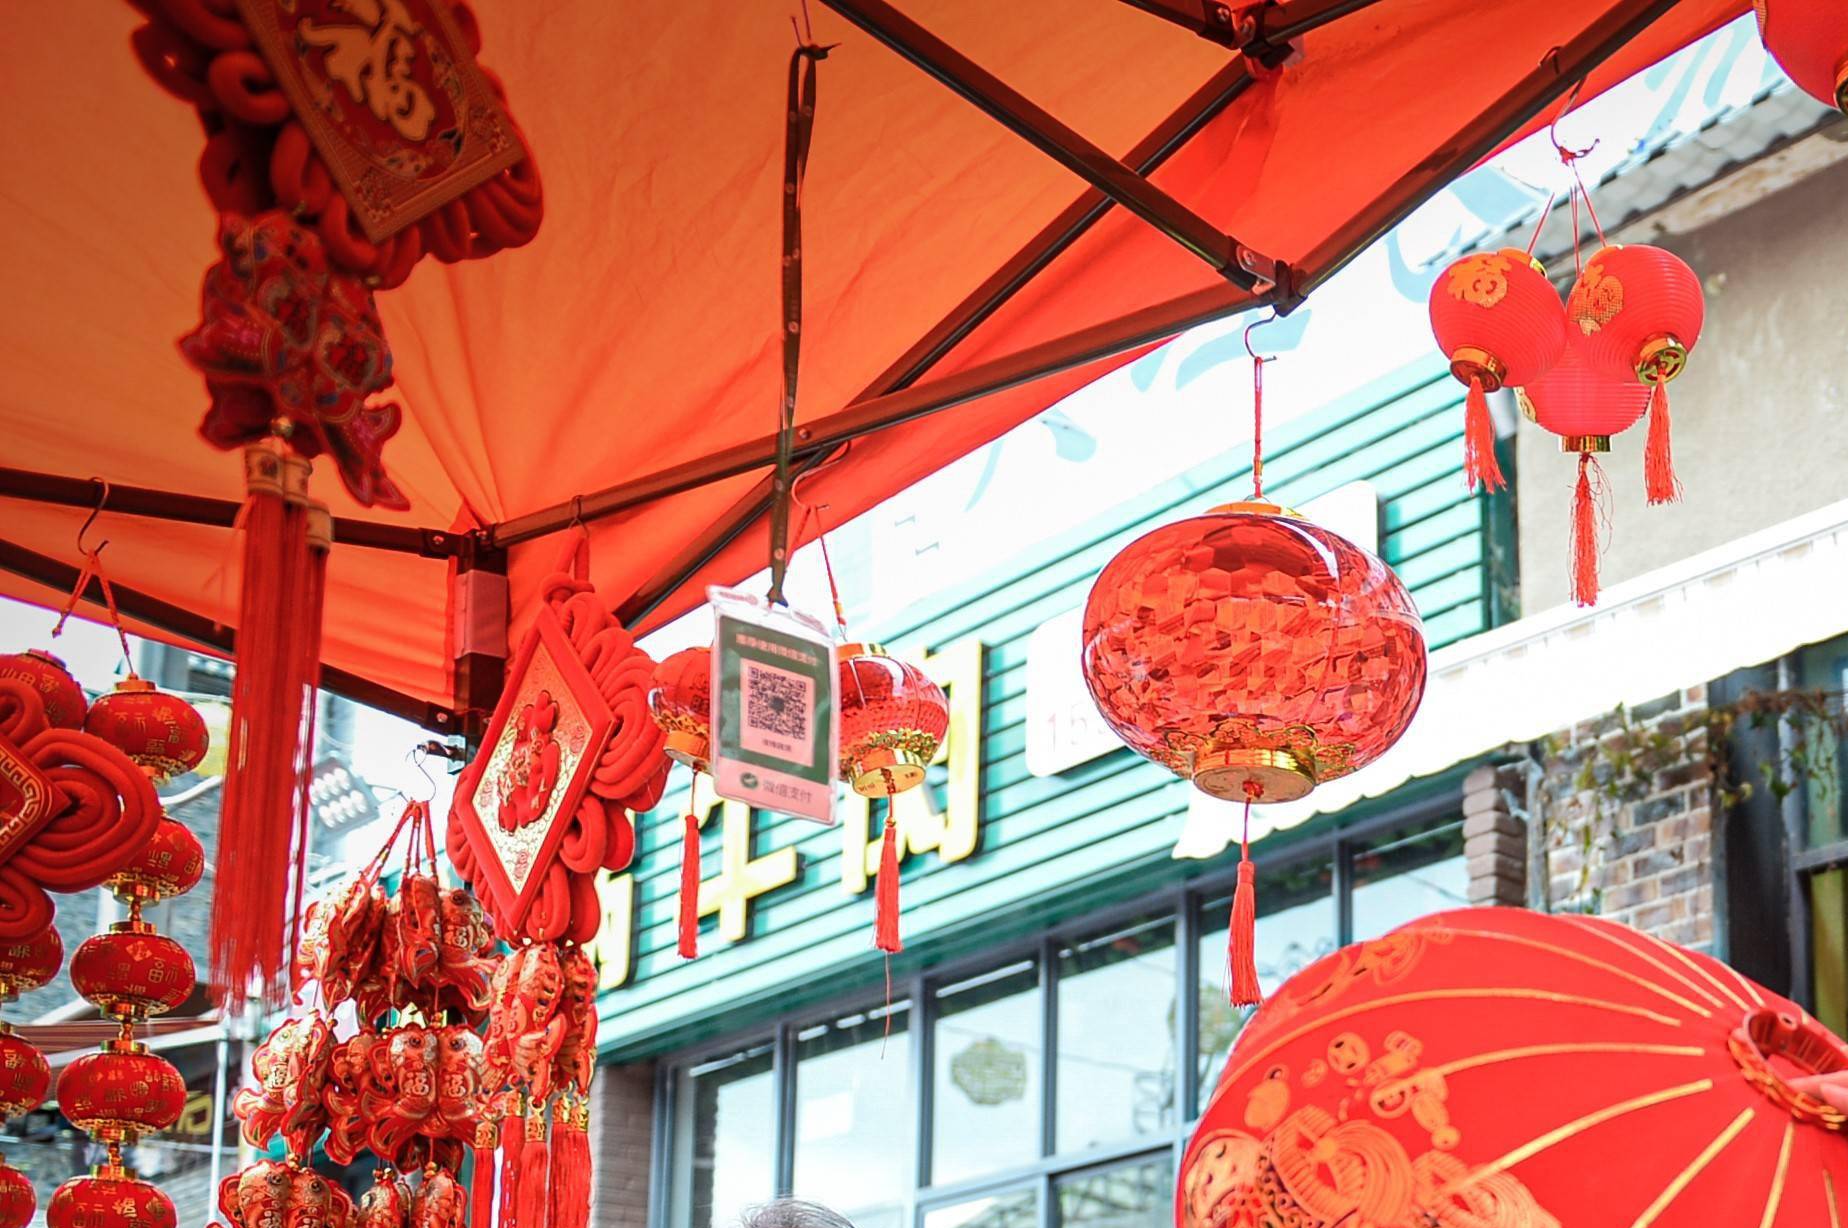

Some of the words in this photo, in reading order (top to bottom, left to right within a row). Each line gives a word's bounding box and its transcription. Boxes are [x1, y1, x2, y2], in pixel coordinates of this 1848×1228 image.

[762, 780, 813, 804] 微信支付
[406, 1072, 430, 1095] 福
[446, 1073, 467, 1097] 福
